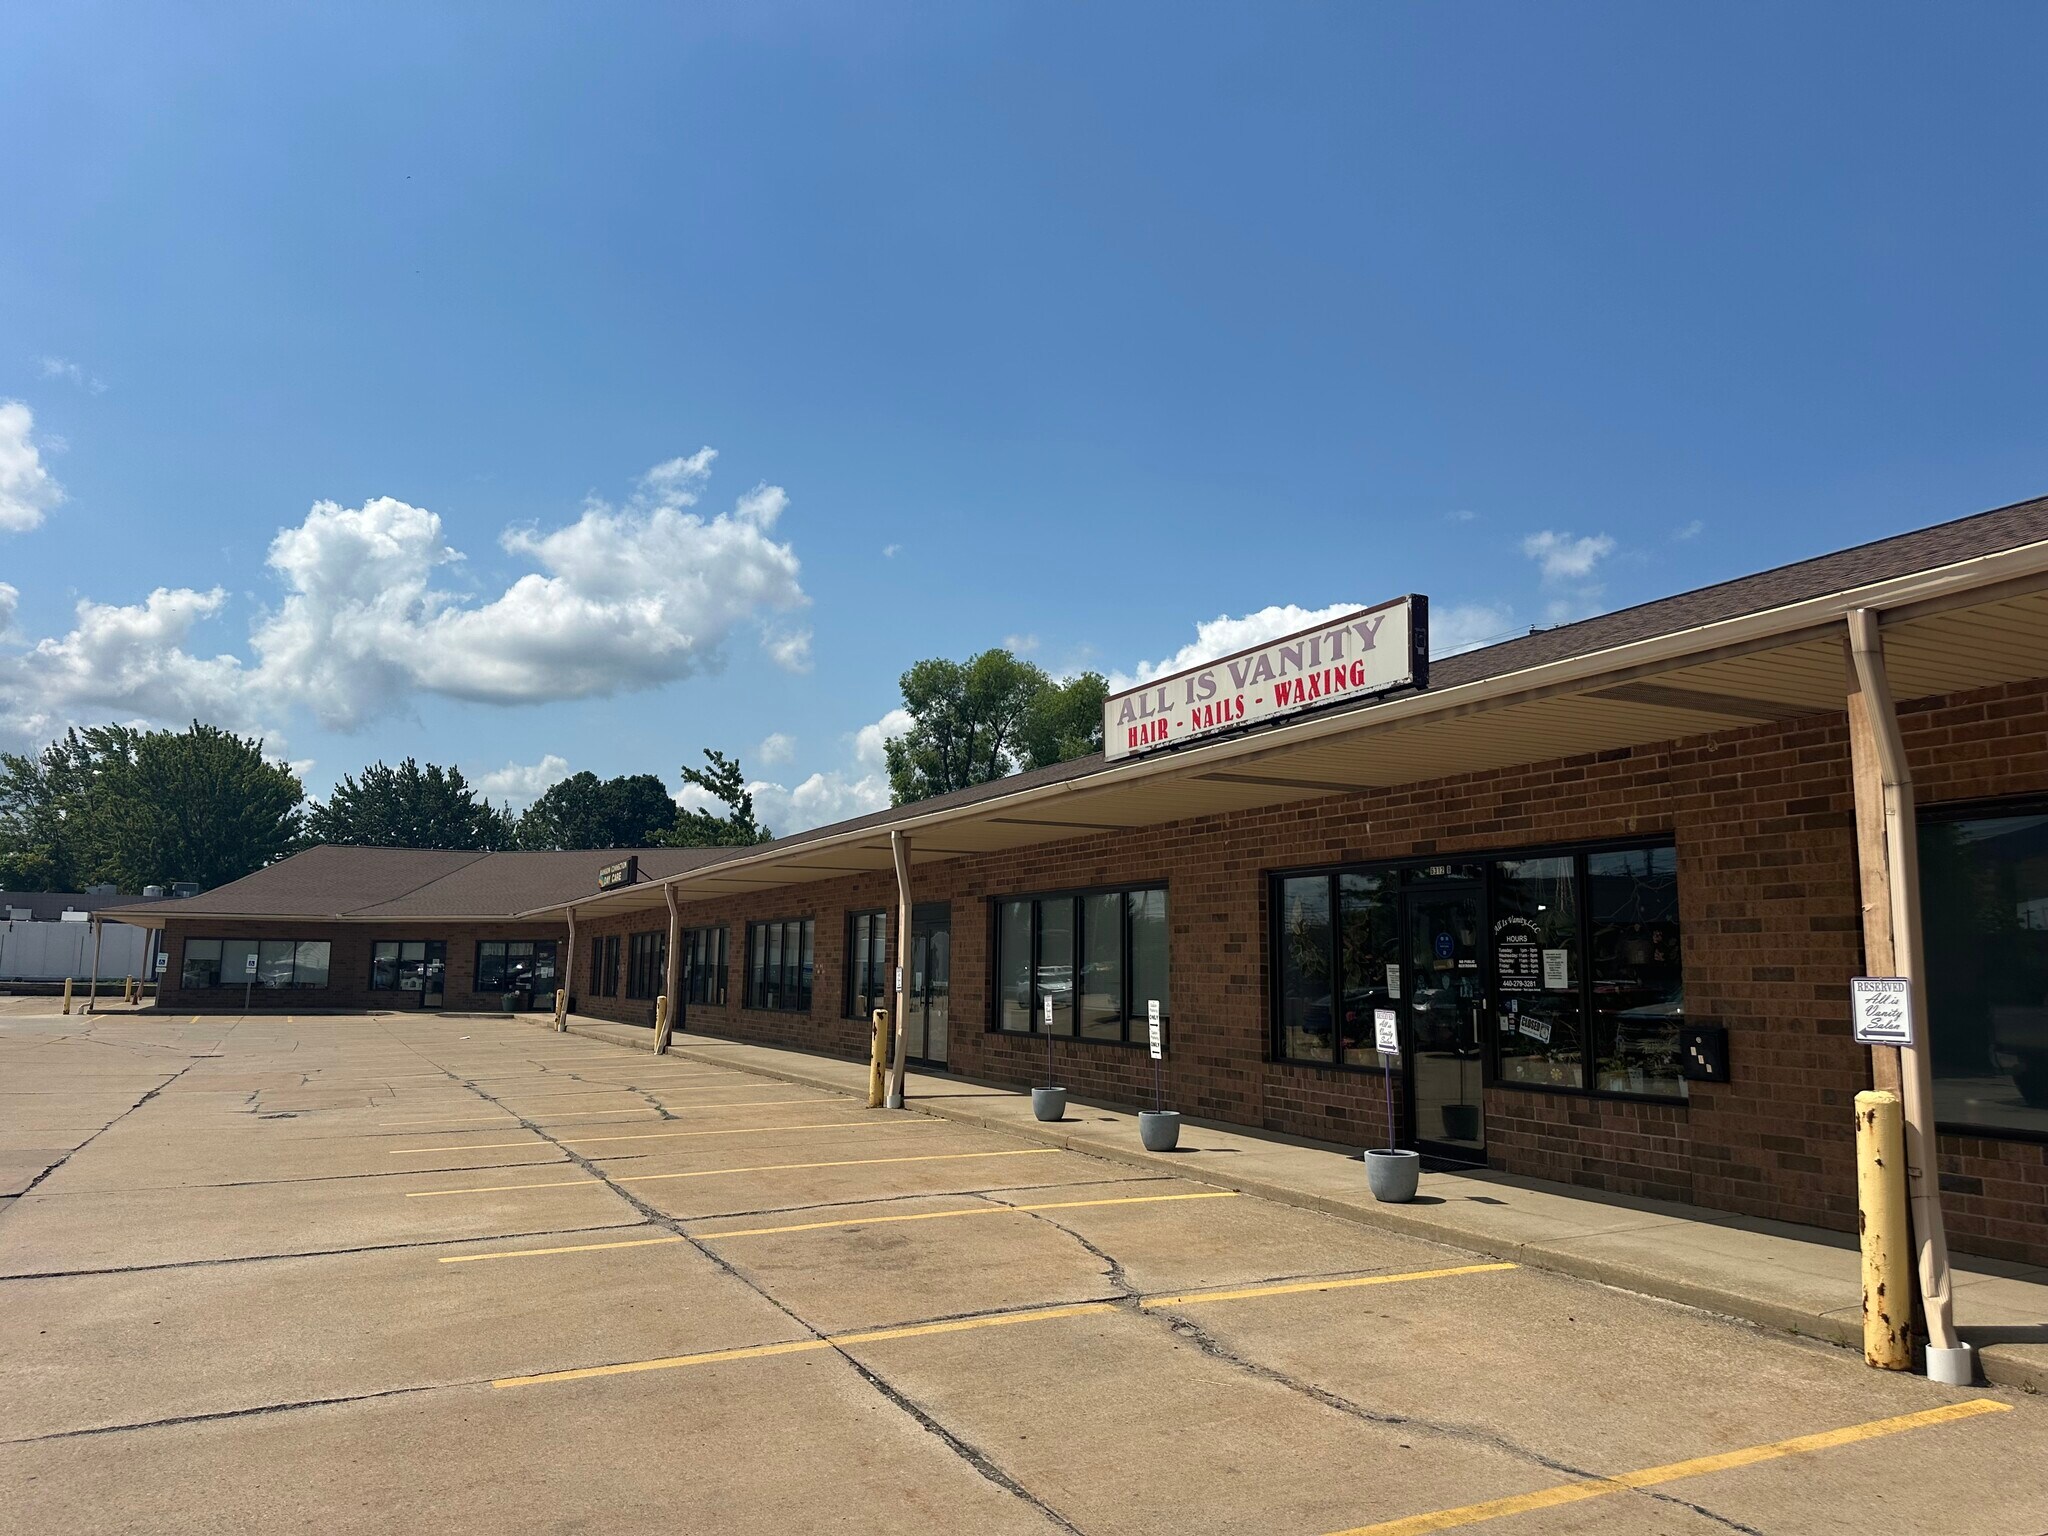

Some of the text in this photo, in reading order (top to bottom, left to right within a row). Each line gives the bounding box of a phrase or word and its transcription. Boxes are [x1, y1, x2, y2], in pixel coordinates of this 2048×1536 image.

[1118, 615, 1385, 725] ALL IS VANITY
[1128, 717, 1168, 748] HAIR
[1192, 694, 1245, 732] NAILS
[1274, 660, 1366, 707] WAXING
[612, 872, 621, 882] CARE
[1857, 982, 1904, 992] RESERVED
[1865, 993, 1890, 1004] All
[1865, 1005, 1902, 1021] Vanity
[1522, 1017, 1540, 1031] CLOSED
[1867, 1018, 1900, 1029] Salon
